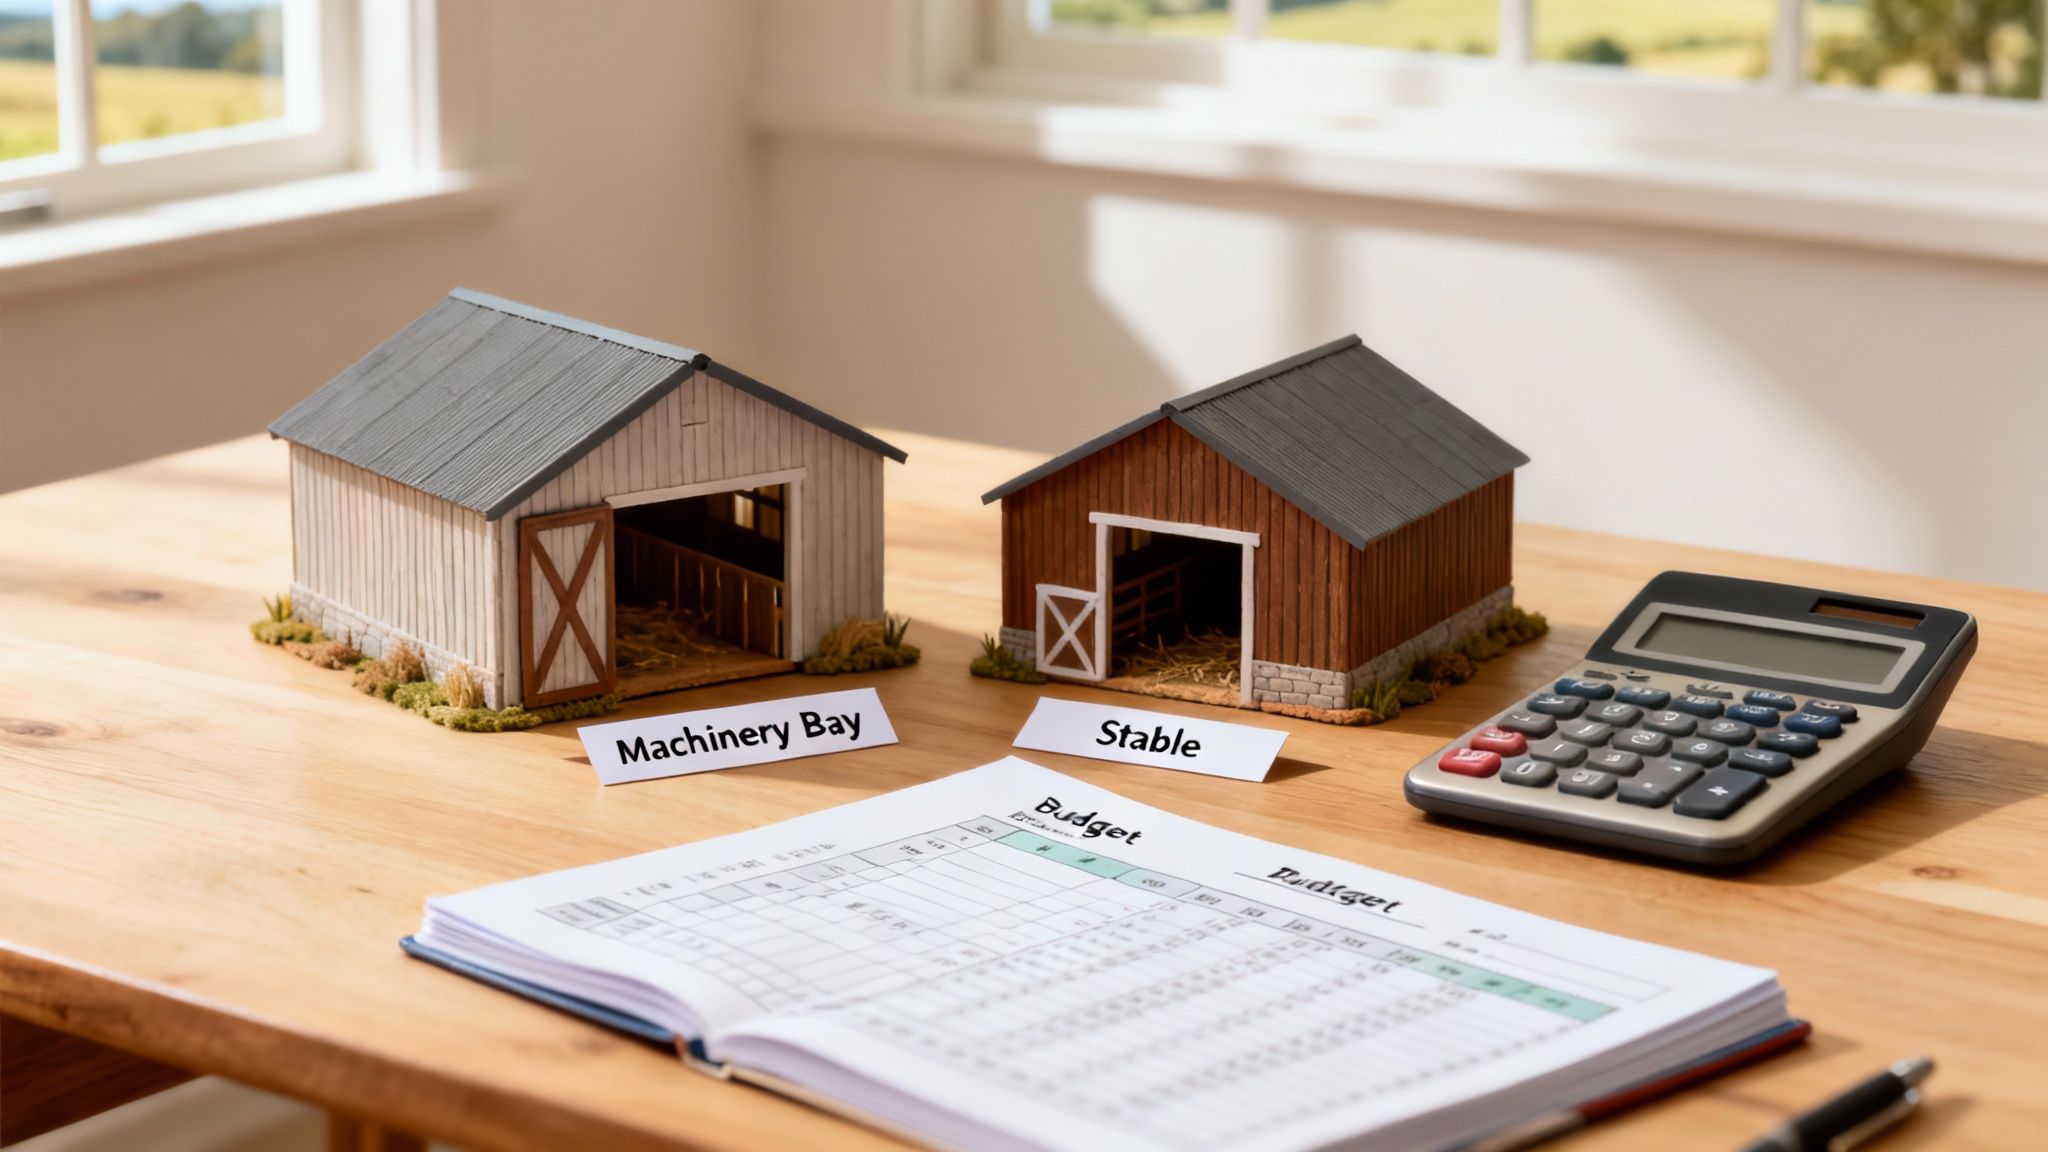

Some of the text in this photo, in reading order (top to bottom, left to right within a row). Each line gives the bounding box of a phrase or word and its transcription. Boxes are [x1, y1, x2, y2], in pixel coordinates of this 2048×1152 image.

[615, 710, 861, 766] Machinery Bay
[1096, 719, 1202, 758] Stable
[1034, 796, 1142, 845] Budget
